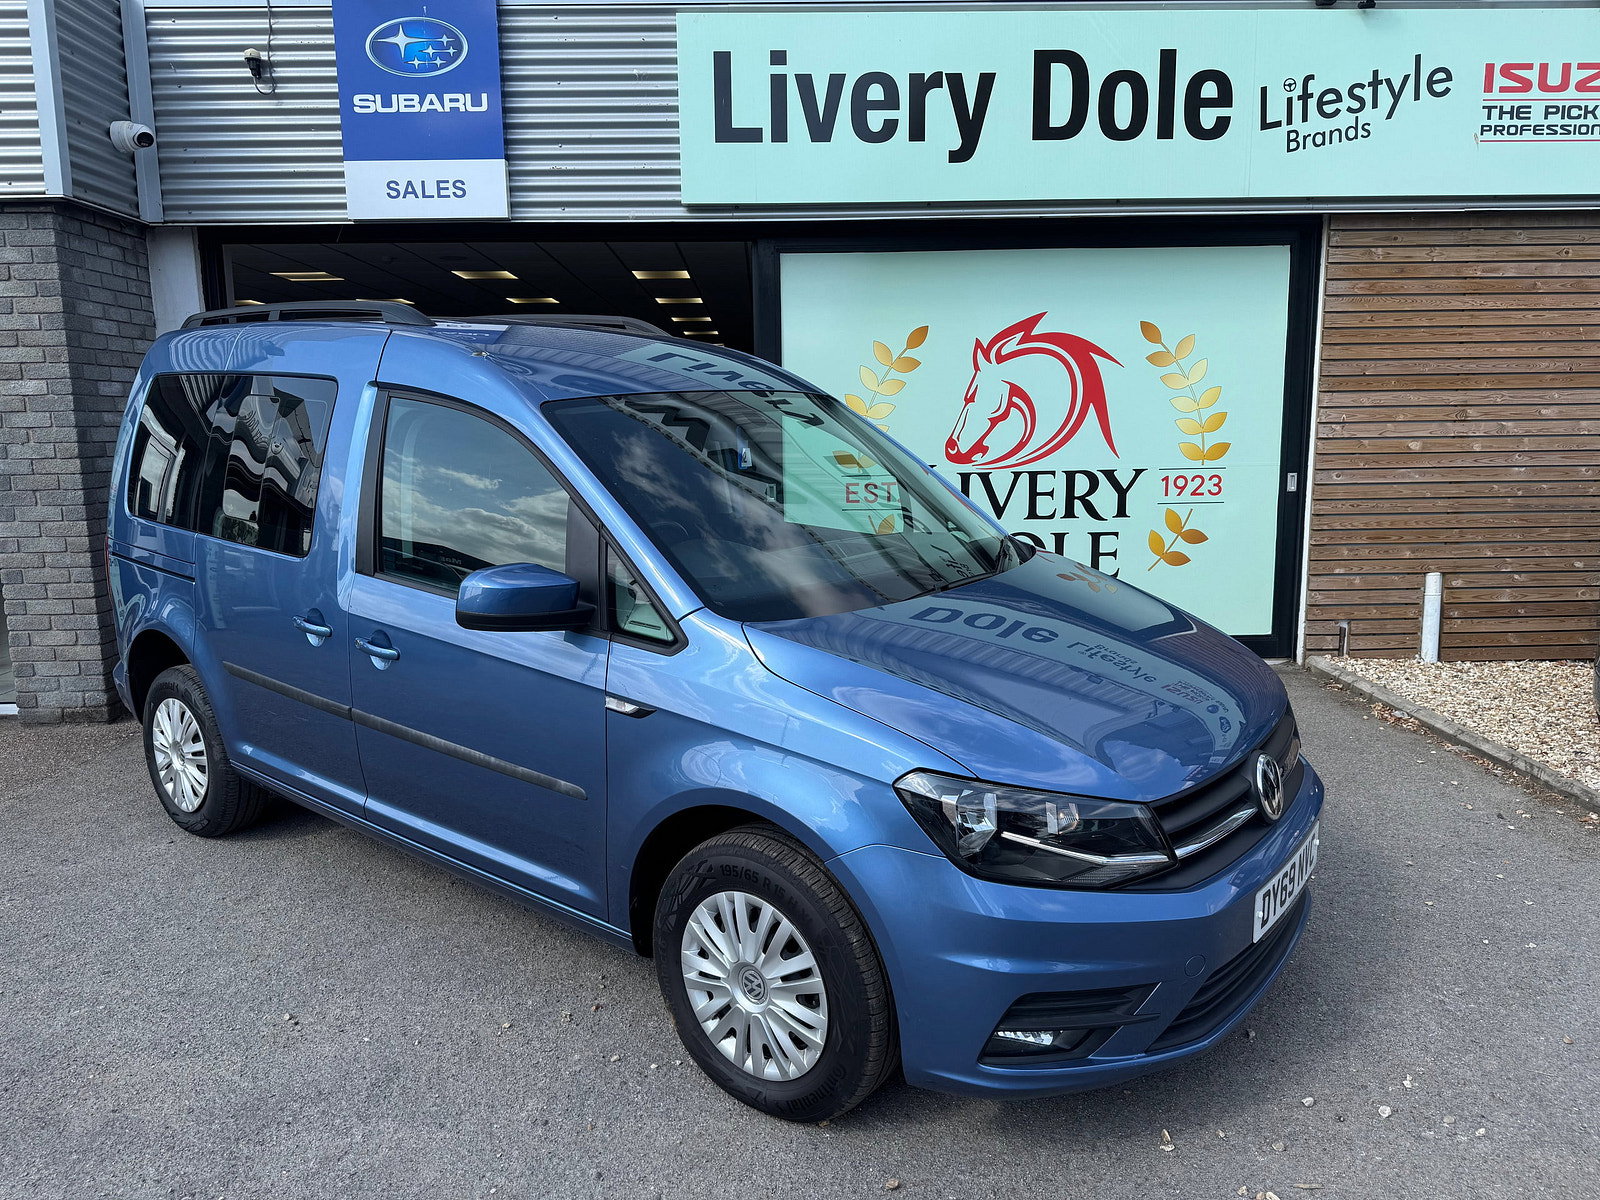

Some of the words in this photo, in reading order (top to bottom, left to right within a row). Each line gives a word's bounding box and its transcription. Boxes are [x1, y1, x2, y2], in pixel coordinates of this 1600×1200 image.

[353, 93, 488, 113] SUBARU
[713, 49, 996, 164] Livery
[1032, 48, 1233, 141] Dole
[1260, 53, 1453, 131] Lifestyle
[1482, 105, 1532, 120] THE
[1544, 105, 1600, 120] PICK
[1286, 116, 1372, 153] Brands
[386, 179, 467, 199] SALES
[1161, 474, 1223, 497] 1923
[1261, 861, 1296, 930] DY69
